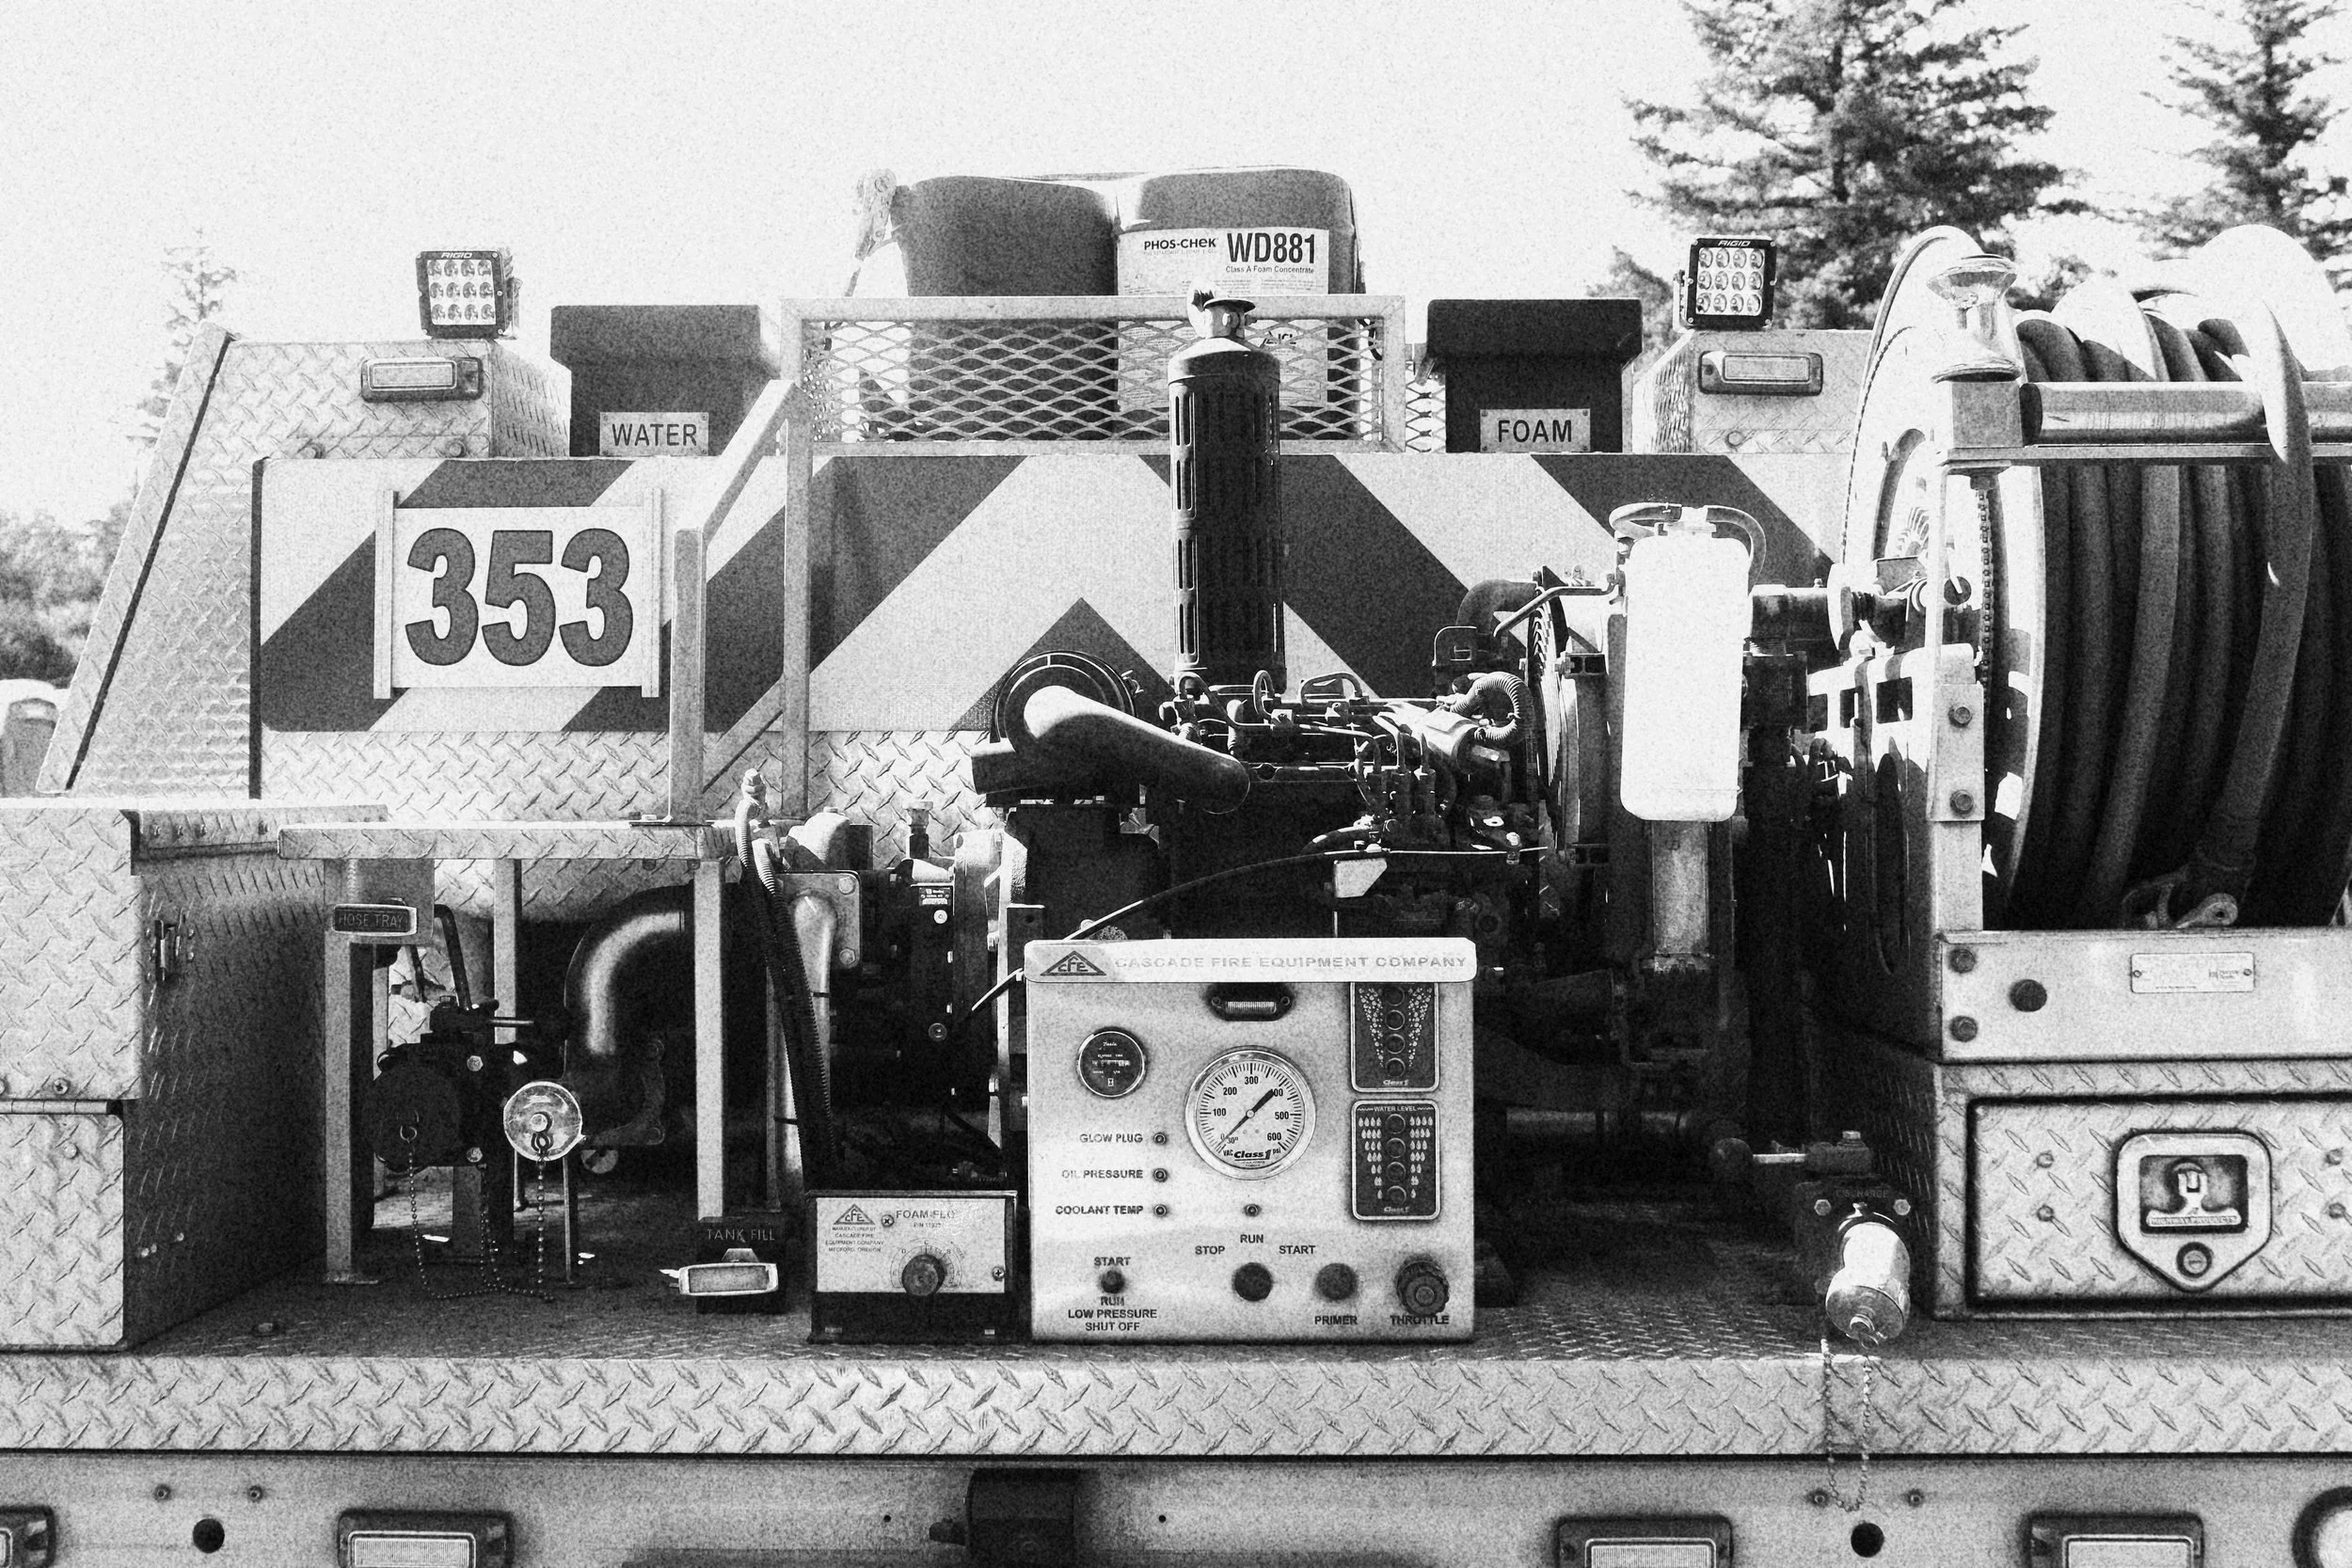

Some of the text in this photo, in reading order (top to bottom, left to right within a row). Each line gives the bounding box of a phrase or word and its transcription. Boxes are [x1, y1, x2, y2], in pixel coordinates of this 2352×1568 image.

[1227, 232, 1315, 264] WD881
[1274, 265, 1315, 275] Concentrate
[612, 423, 698, 447] WATER
[1498, 419, 1573, 444] FOAM
[405, 528, 634, 667] 353
[339, 912, 404, 928] HOSE TRAY
[1115, 957, 1467, 968] CASCADE FIRE EQUIPMENT COMPANY
[1244, 1076, 1259, 1085] 300
[1223, 1087, 1237, 1096] 200
[1270, 1088, 1283, 1097] 00
[1213, 1108, 1227, 1117] 100
[1274, 1112, 1289, 1120] 500
[1079, 1133, 1143, 1143] GLOW PLUG
[1267, 1132, 1281, 1141] 600
[1061, 1169, 1144, 1179] OIL PRESSURE
[1055, 1205, 1144, 1215] COOLANT TEMP
[707, 1228, 775, 1242] TANK FILL
[1240, 1234, 1264, 1243] RUN
[1195, 1245, 1226, 1255] STOP
[1279, 1244, 1316, 1255] START
[1093, 1257, 1131, 1266] START
[1100, 1296, 1125, 1307] RUN
[1068, 1309, 1157, 1319] LOW PRESSURE
[1314, 1315, 1358, 1325] PRIMER
[1390, 1315, 1450, 1324] THROTTLE
[1085, 1322, 1140, 1331] SHUT OFF
